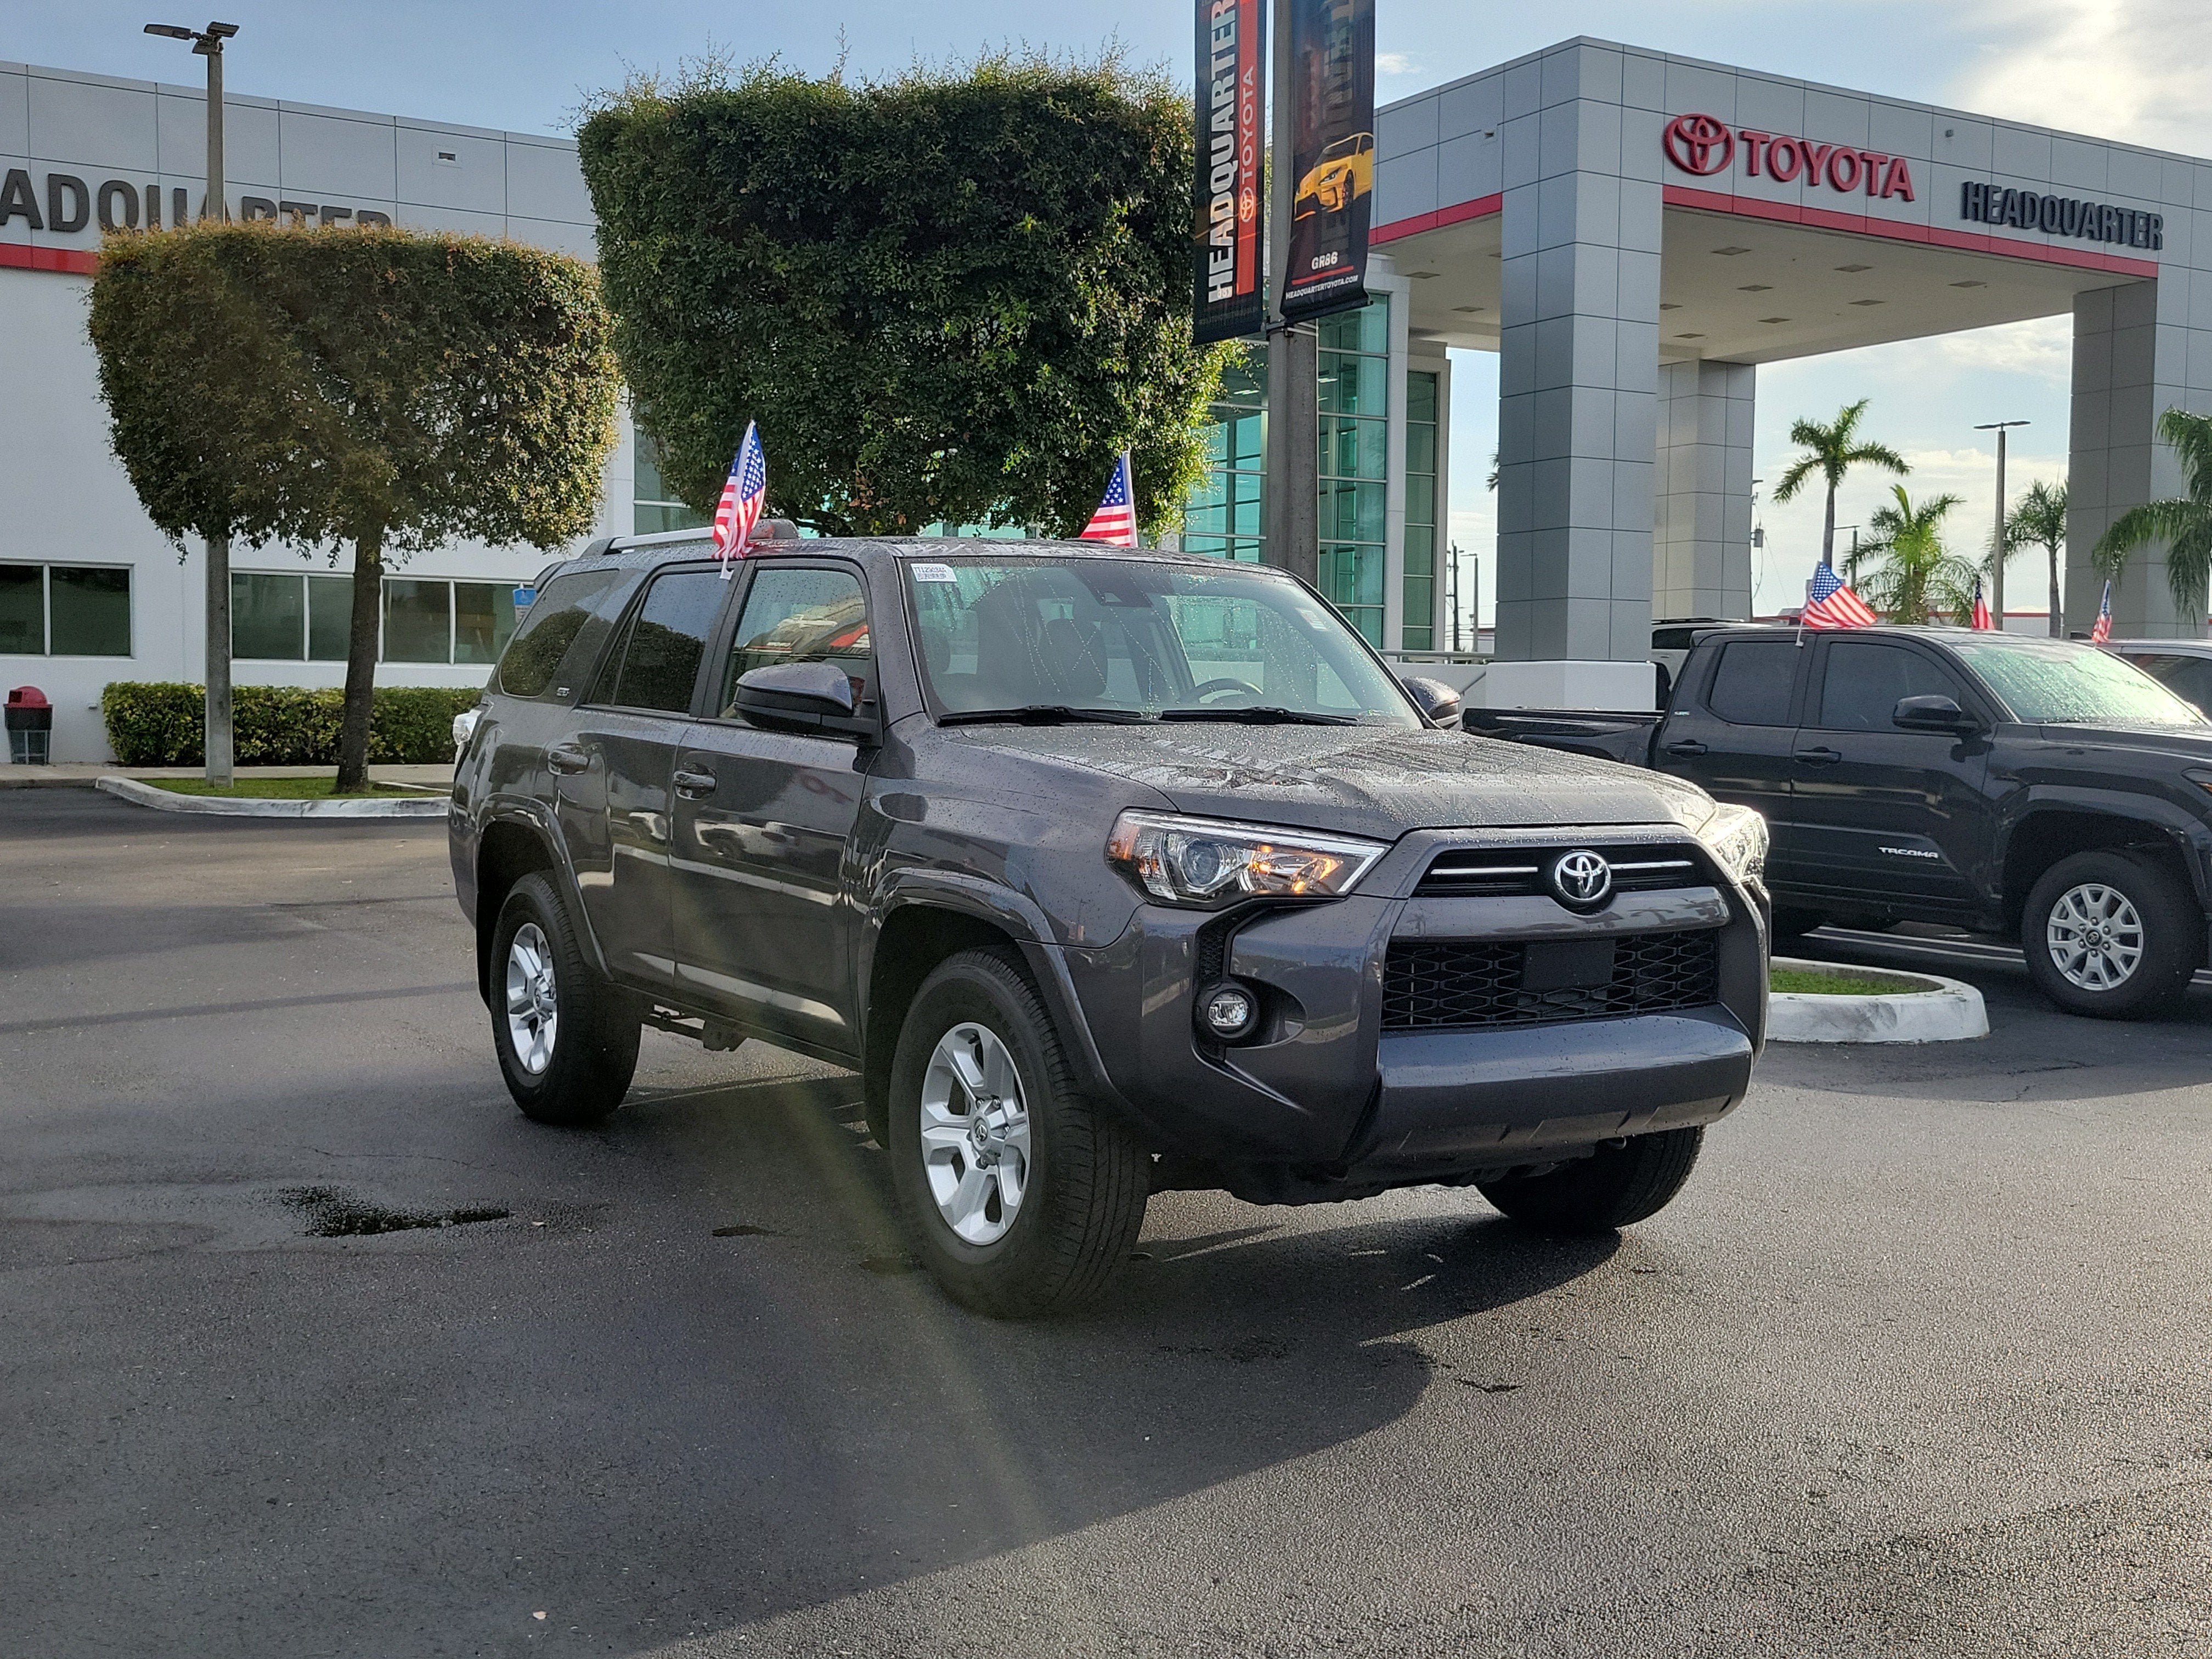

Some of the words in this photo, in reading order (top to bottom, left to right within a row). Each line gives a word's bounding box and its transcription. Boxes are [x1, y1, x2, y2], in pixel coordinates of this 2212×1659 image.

[1208, 0, 1237, 303] HEADQUARTER
[1240, 66, 1254, 185] TOYOTA
[1740, 130, 1915, 201] TOYOTA
[1961, 182, 2164, 250] HEADQUARTER
[1285, 274, 1358, 300] HEADQUARTERTOYOTA.COM
[1311, 251, 1339, 270] GR86
[1878, 847, 1939, 859] TACOMA
